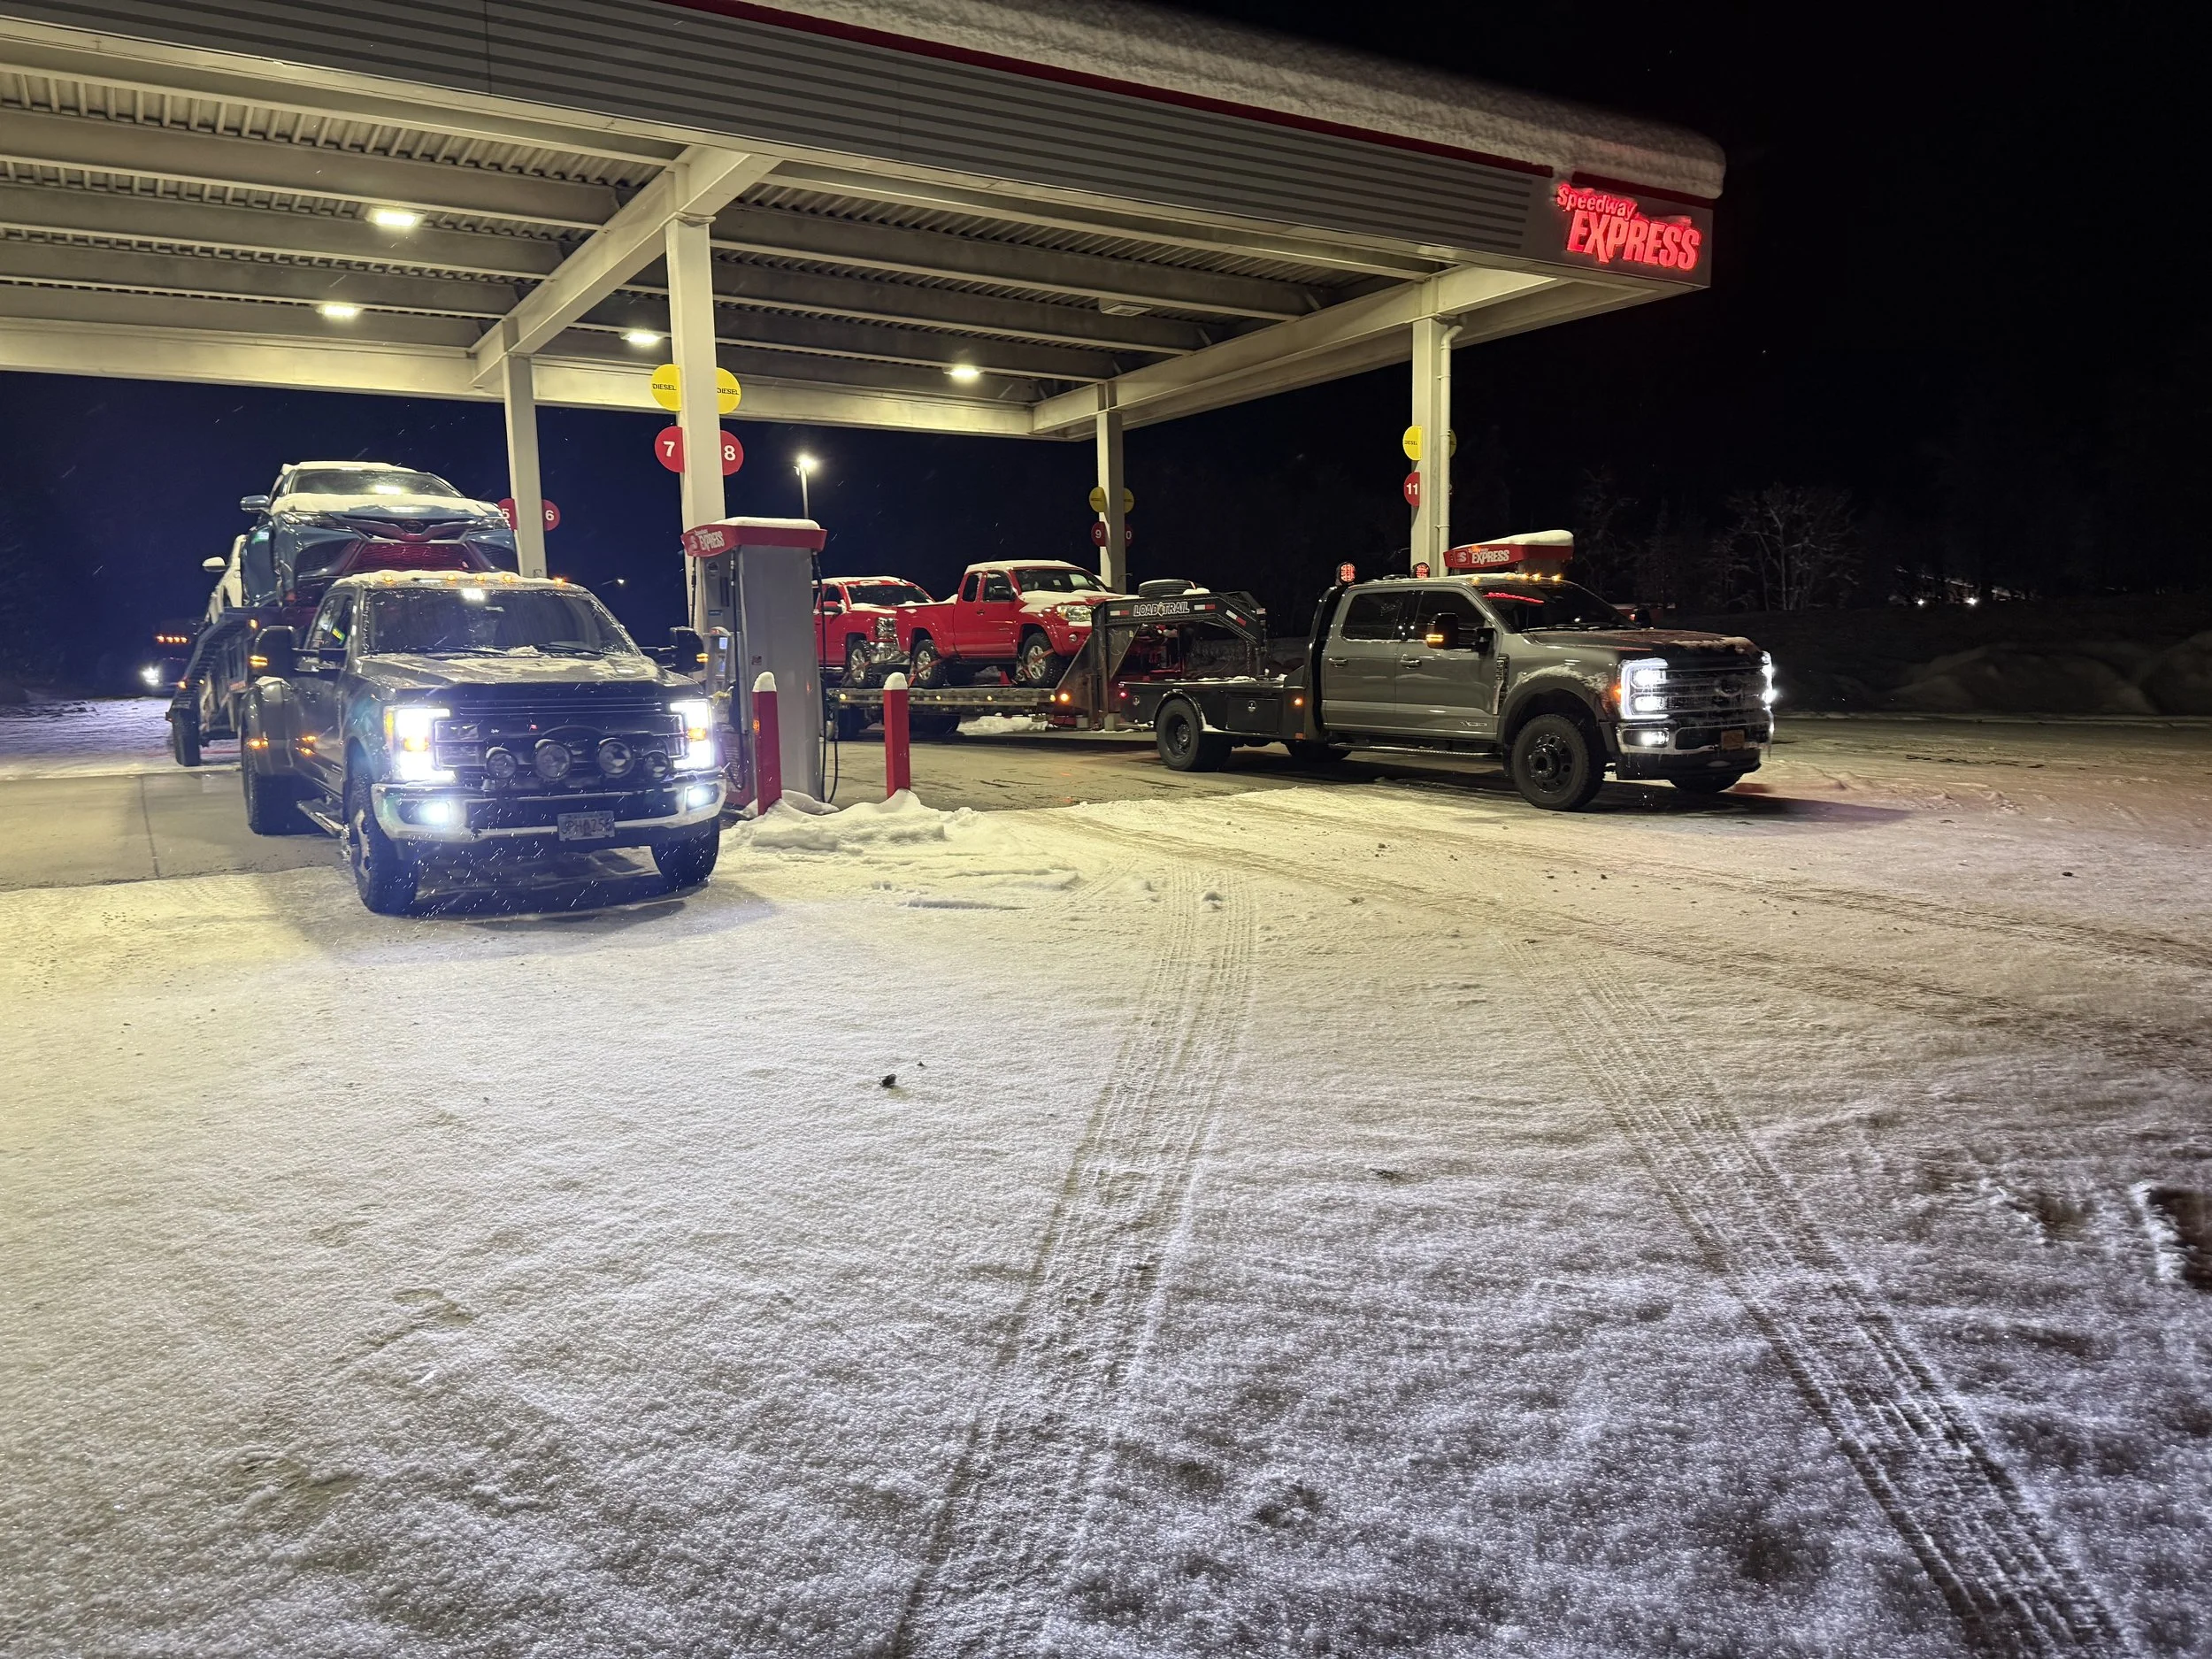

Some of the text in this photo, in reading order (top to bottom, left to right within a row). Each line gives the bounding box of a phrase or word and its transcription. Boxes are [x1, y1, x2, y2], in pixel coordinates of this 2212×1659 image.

[1557, 184, 1637, 220] Speedway
[1567, 210, 1701, 270] EXPRESS
[651, 382, 677, 391] DIESEL
[717, 387, 740, 396] DIESEL
[663, 441, 675, 457] 7
[724, 445, 736, 461] 8
[1406, 482, 1418, 495] 11
[502, 508, 511, 520] 5
[545, 510, 555, 521] 6
[1094, 529, 1102, 539] 9
[1125, 530, 1133, 540] 0
[1471, 549, 1509, 565] EXPRESS
[1133, 602, 1190, 617] LOAD TRAIL
